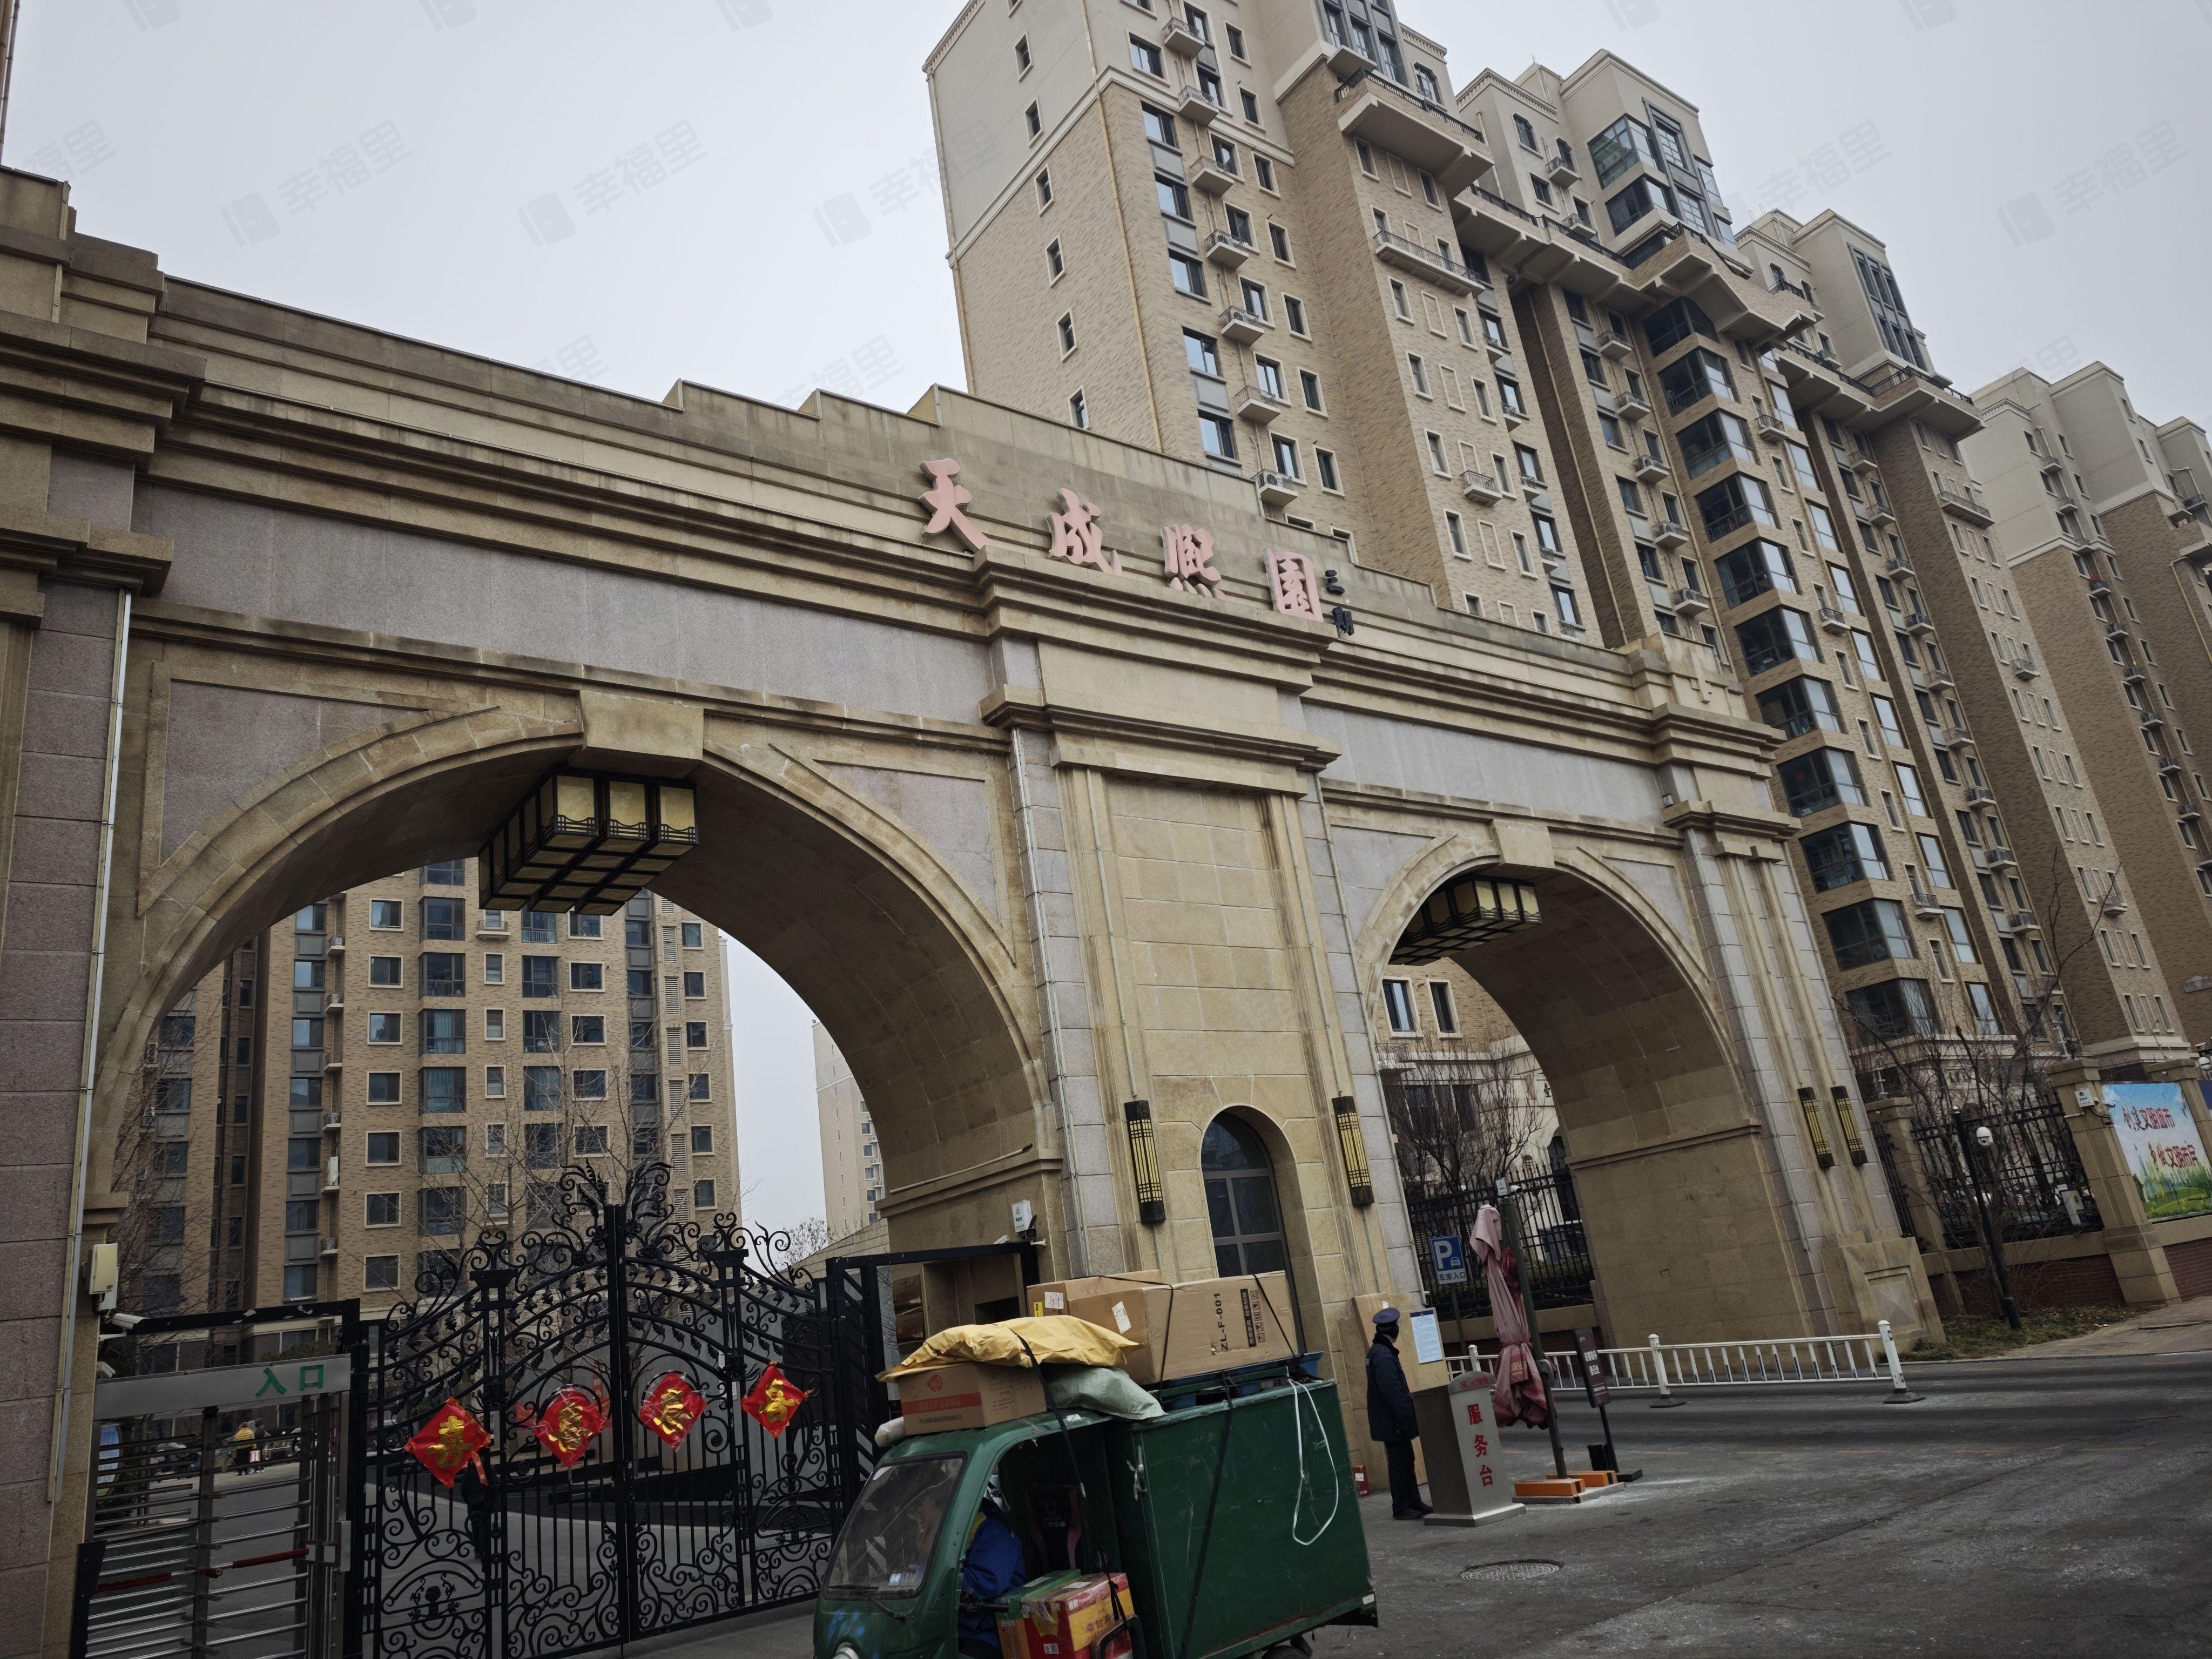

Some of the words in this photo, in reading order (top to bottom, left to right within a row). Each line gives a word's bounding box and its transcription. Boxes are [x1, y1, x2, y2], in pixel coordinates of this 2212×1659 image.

[2121, 1104, 2176, 1131] 创建文明城市
[1434, 1240, 1453, 1270] P
[1438, 1272, 1466, 1282] 车库入口
[1213, 1293, 1229, 1351] ZL-F-001
[256, 1364, 325, 1397] 入口
[426, 1415, 475, 1469] 喜
[1467, 1402, 1494, 1488] 服务台
